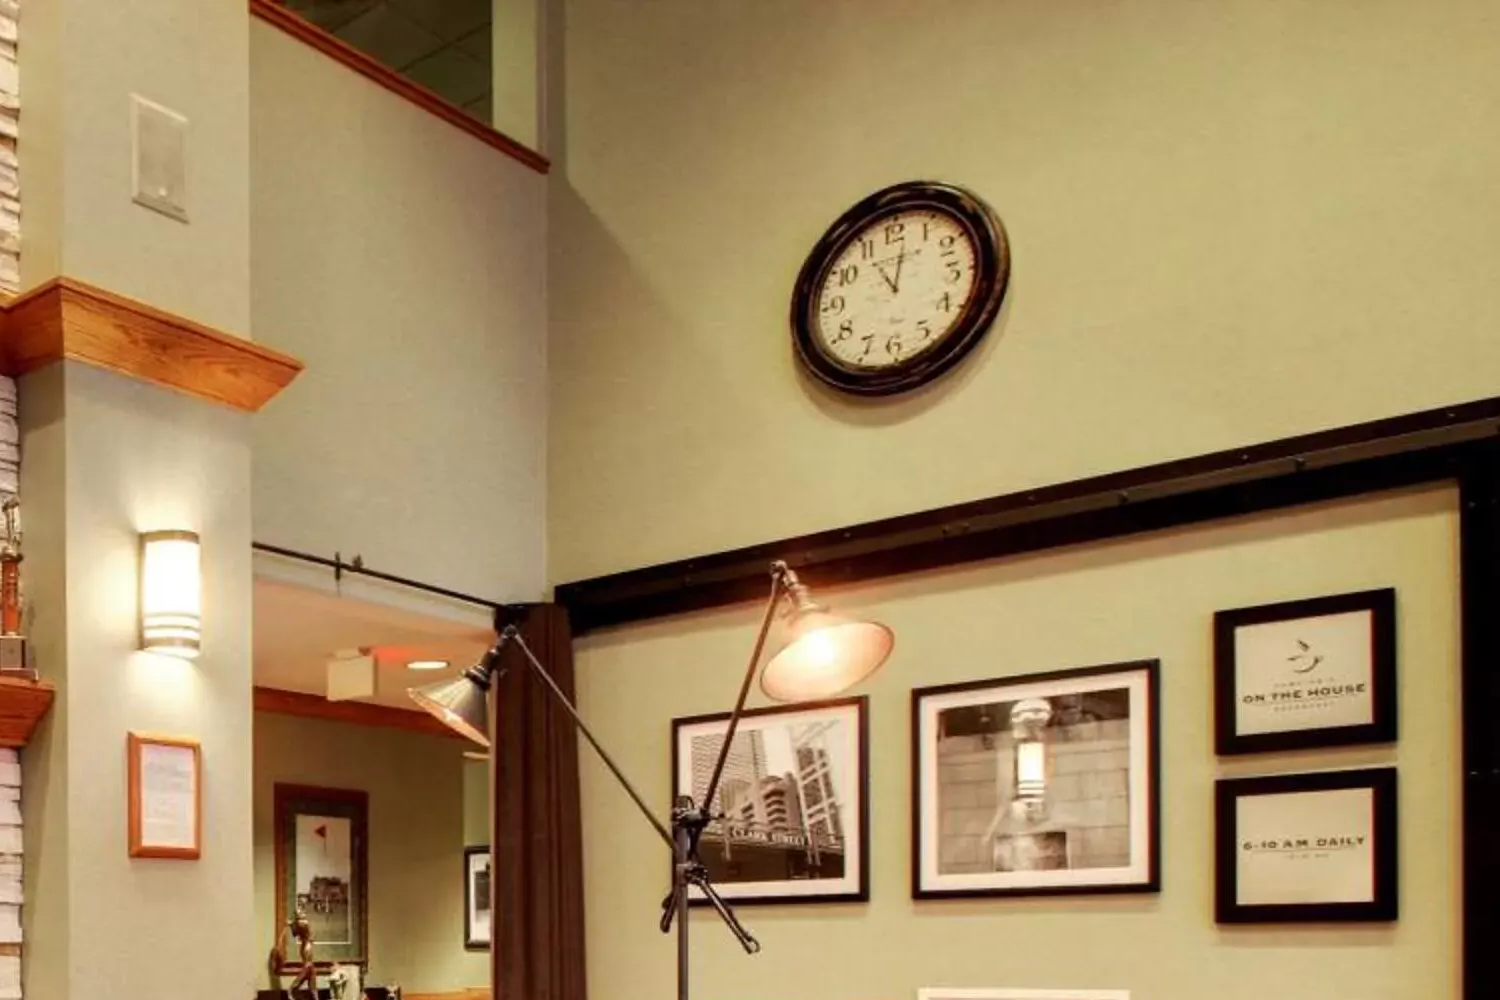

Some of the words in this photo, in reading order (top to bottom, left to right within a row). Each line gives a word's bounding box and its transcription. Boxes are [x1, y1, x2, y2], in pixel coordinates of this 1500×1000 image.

[884, 223, 904, 245] 12
[923, 223, 928, 242] 1
[861, 240, 873, 261] 11
[939, 235, 955, 257] 2
[839, 264, 859, 287] 10
[943, 260, 961, 282] 3
[830, 295, 845, 316] 9
[936, 291, 950, 313] 4
[838, 319, 853, 341] 8
[915, 319, 931, 339] 5
[861, 333, 874, 355] 7
[885, 334, 902, 355] 6
[1243, 695, 1265, 705] ON
[1271, 689, 1302, 700] THE
[1307, 683, 1365, 697] HOUSE
[1316, 836, 1364, 847] DAILY
